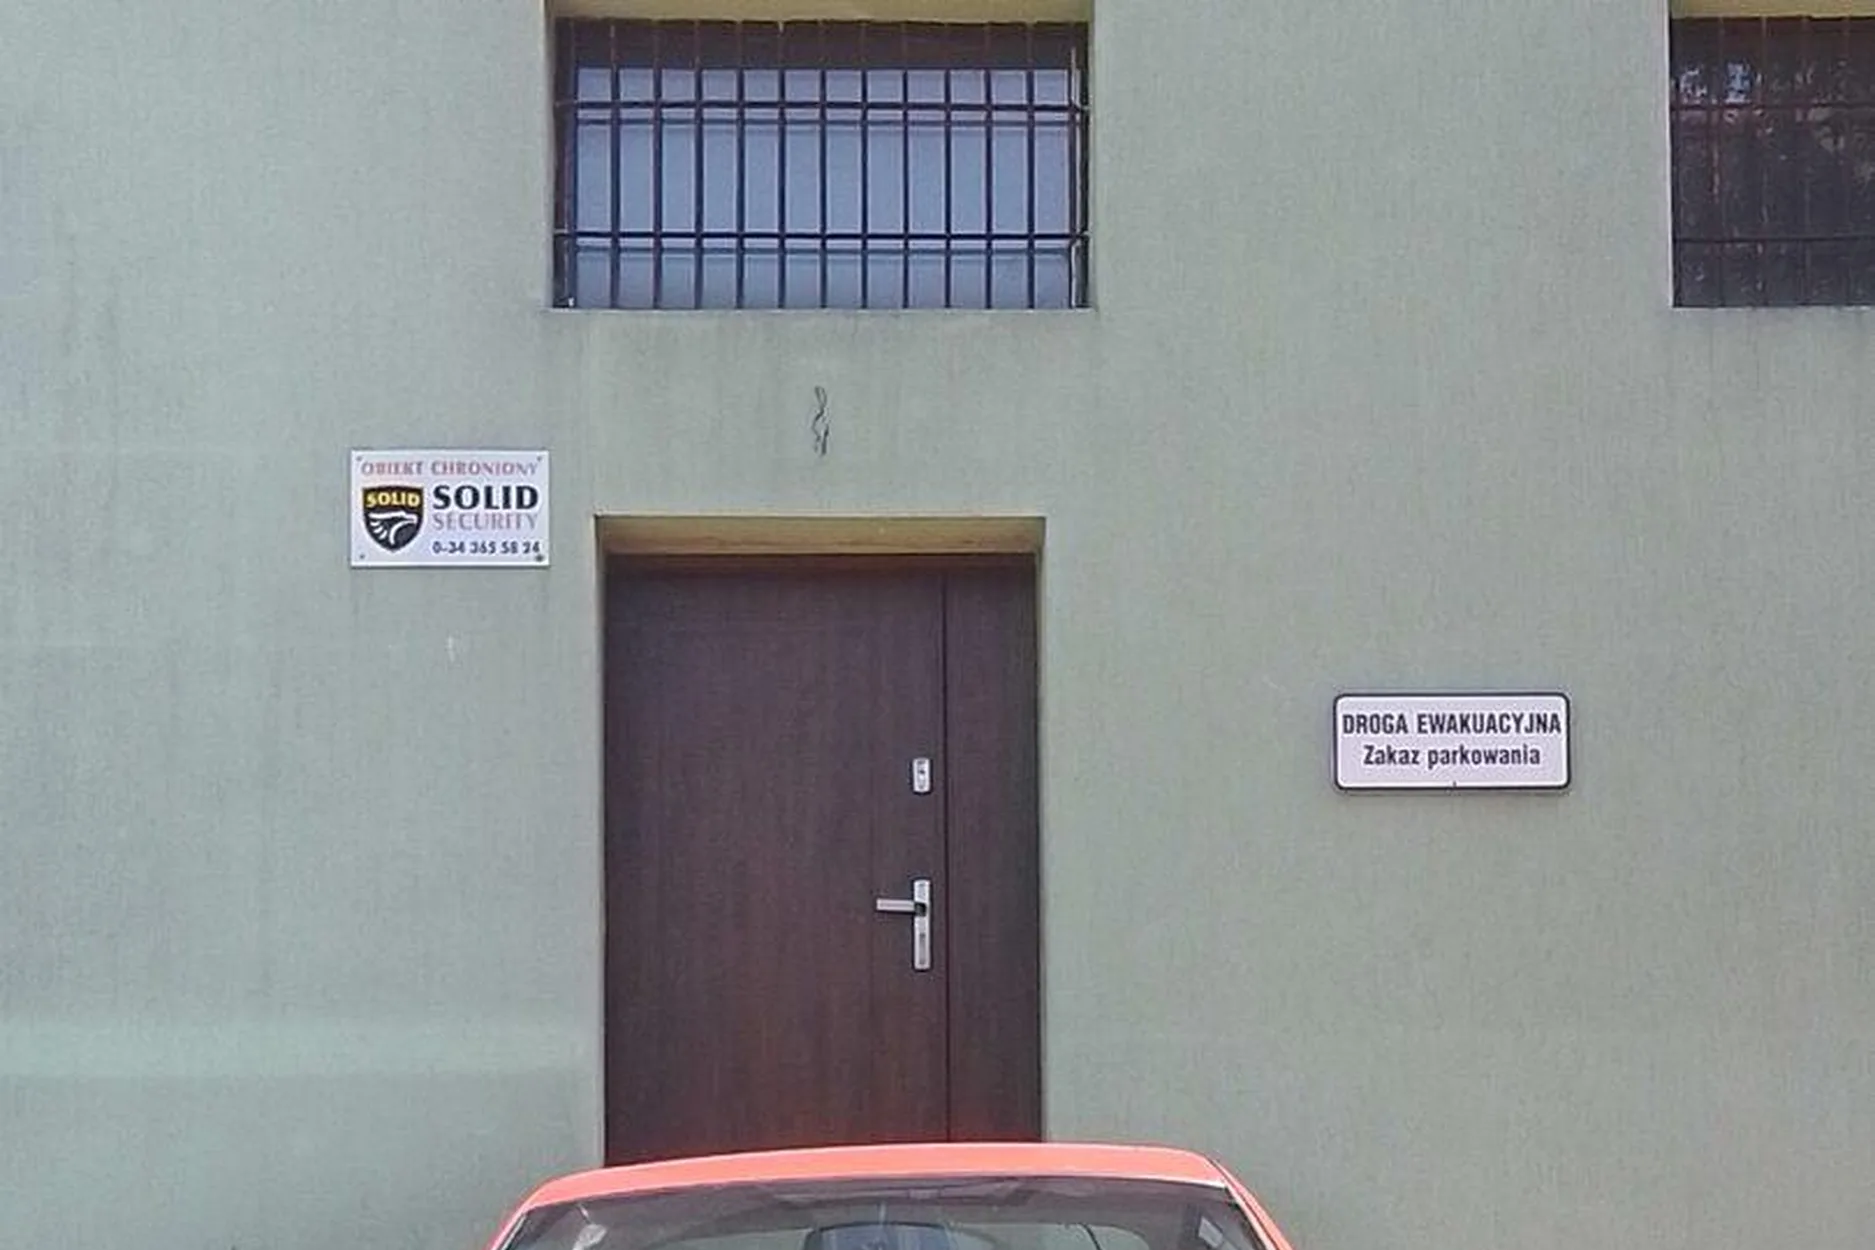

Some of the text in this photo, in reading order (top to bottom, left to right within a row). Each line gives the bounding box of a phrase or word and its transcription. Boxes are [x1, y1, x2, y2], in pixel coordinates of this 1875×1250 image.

[361, 461, 539, 476] OBIEKT CHRONIONY
[366, 492, 421, 508] SOLID
[432, 485, 539, 510] SOLID
[432, 513, 539, 531] SECURITY
[501, 541, 519, 555] 58
[1342, 713, 1561, 734] DROGA EWAKUACYJNA
[1363, 743, 1541, 770] Zakaz parkowania
